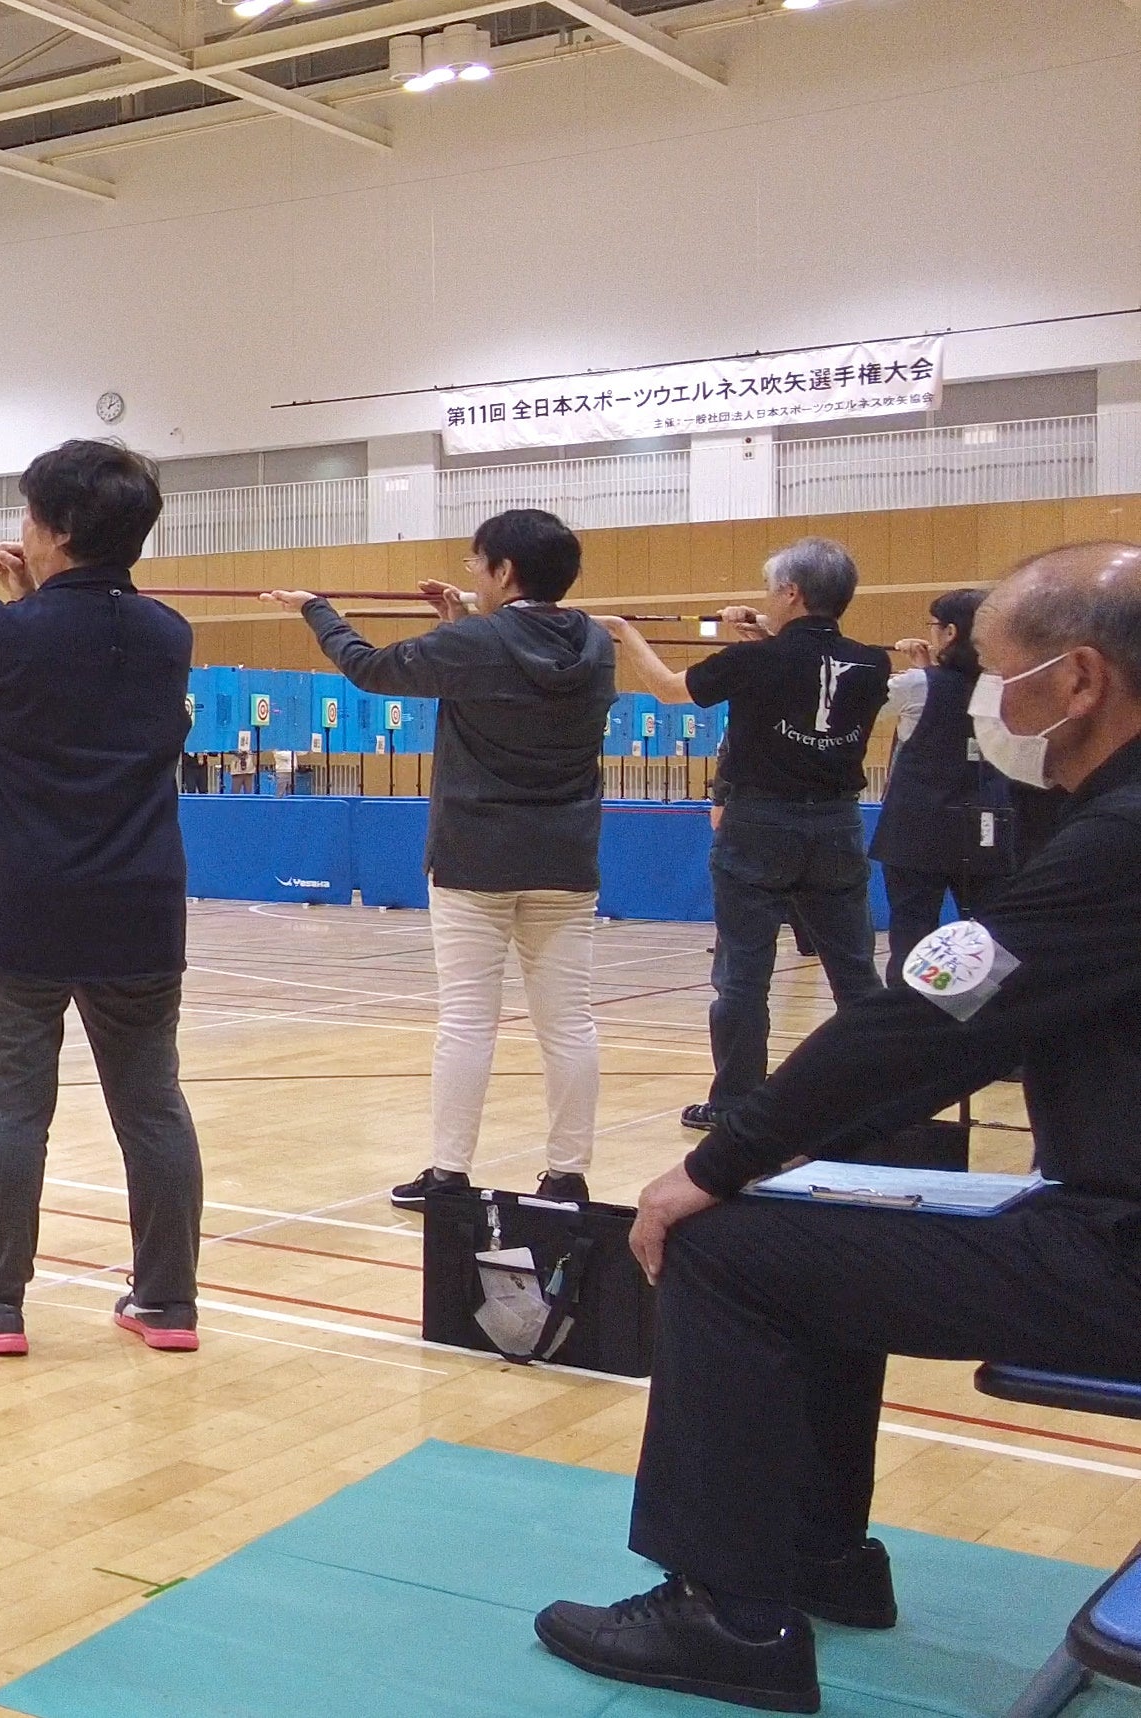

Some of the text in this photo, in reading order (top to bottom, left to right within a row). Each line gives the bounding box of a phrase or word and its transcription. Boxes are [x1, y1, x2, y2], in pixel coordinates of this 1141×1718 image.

[446, 402, 507, 427] 第11回
[773, 718, 816, 747] Never
[817, 735, 844, 751] give
